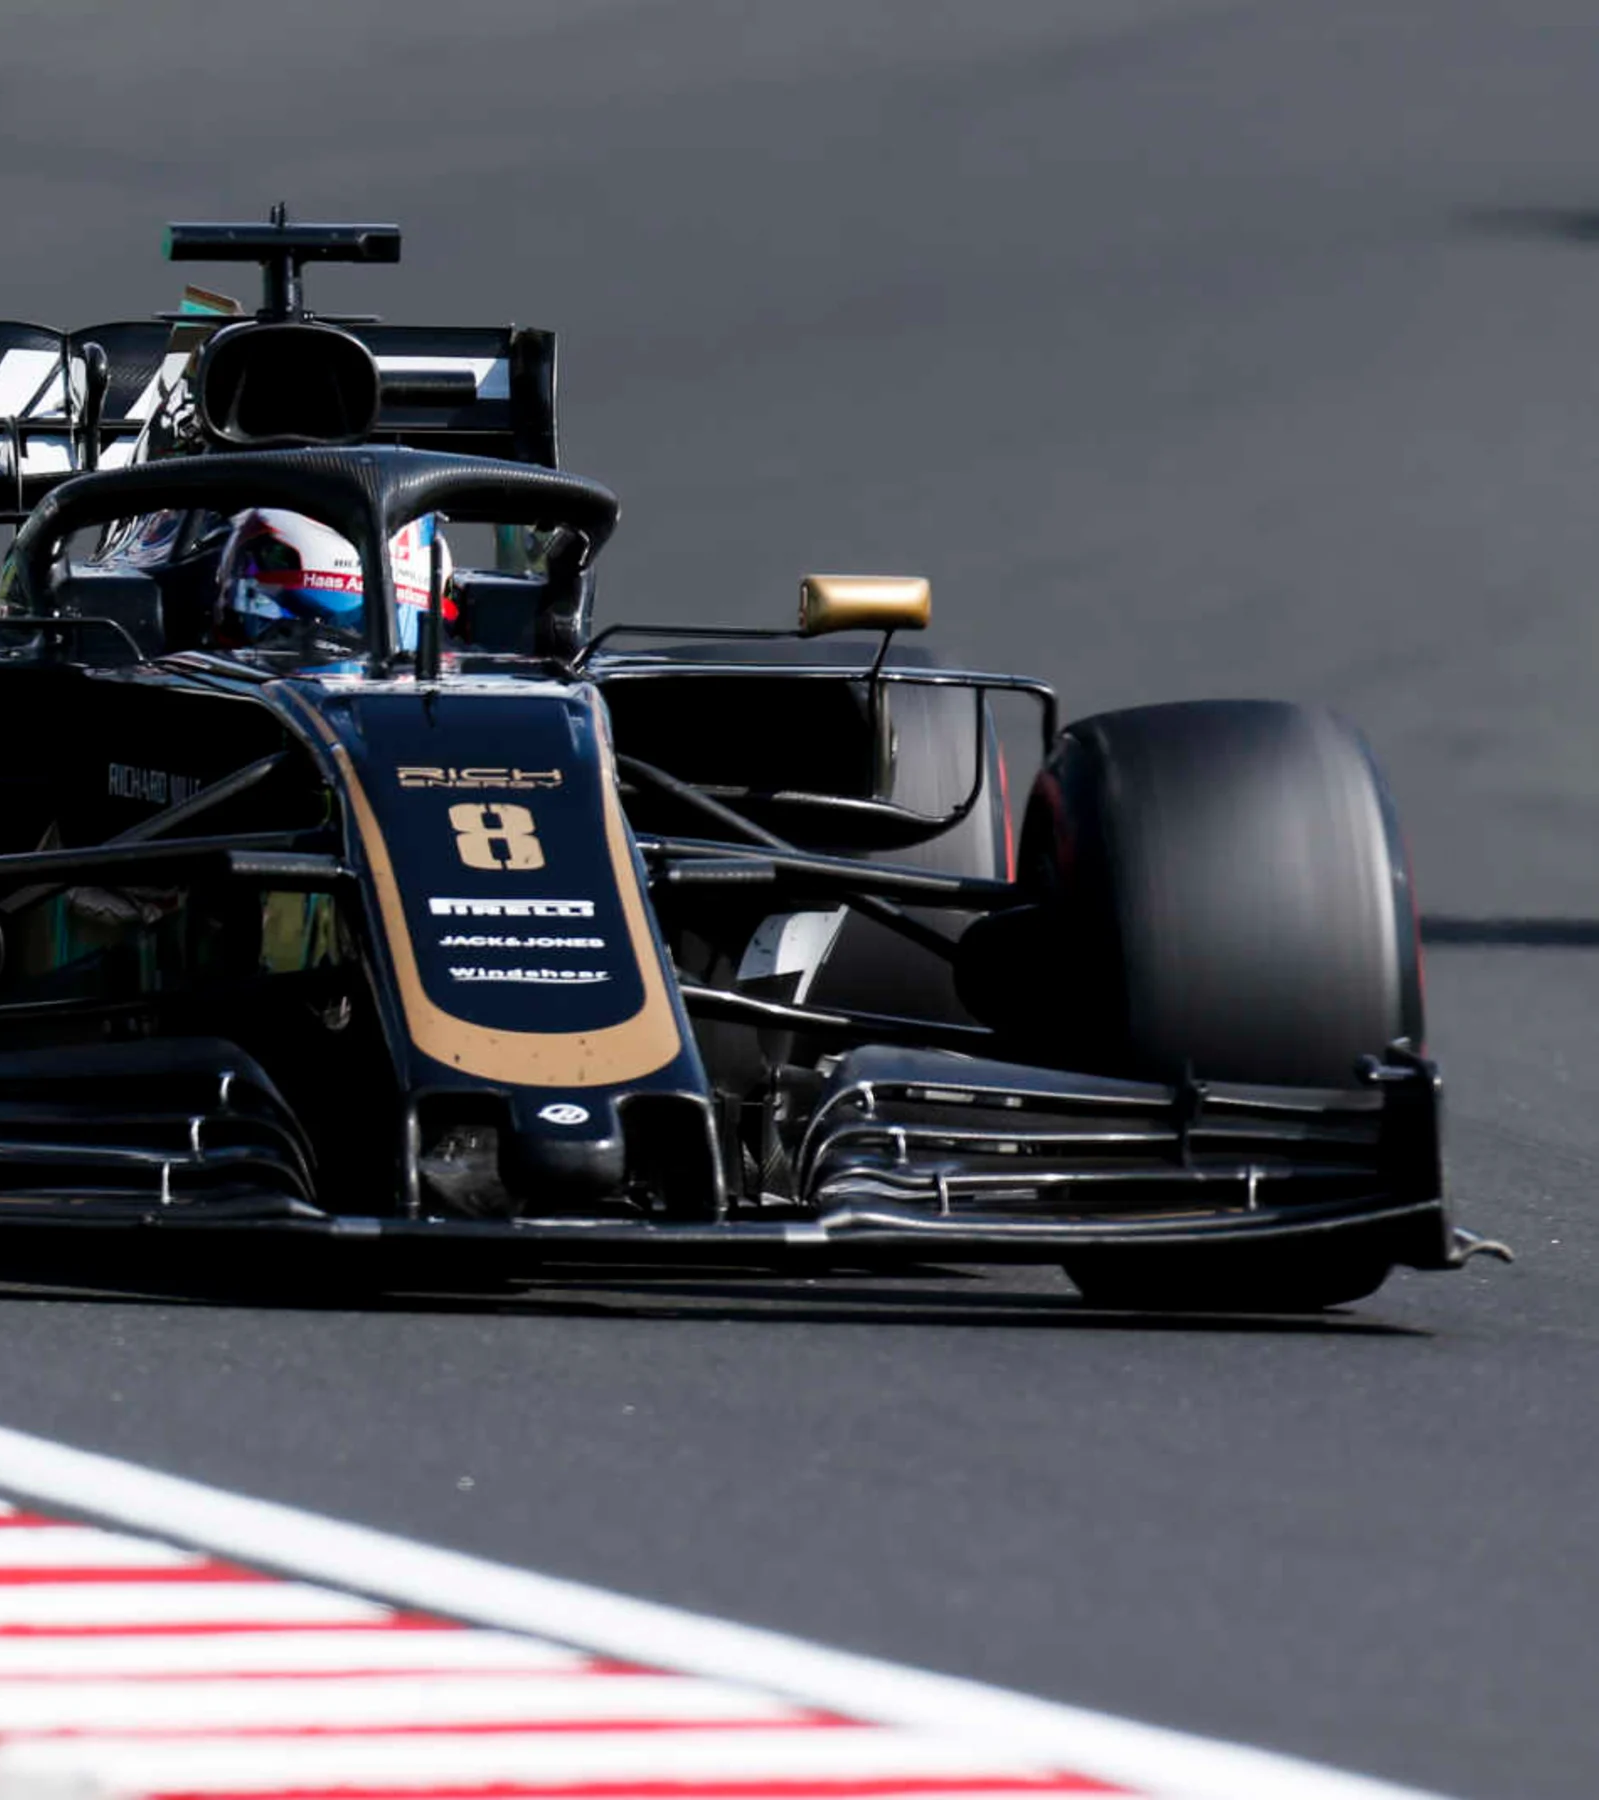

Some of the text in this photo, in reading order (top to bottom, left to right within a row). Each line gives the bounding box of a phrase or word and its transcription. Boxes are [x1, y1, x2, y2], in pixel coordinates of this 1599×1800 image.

[303, 573, 343, 589] Haas
[396, 767, 563, 781] RICH
[108, 762, 167, 804] RICHARD
[400, 779, 564, 789] ENERGY
[448, 802, 546, 871] 8
[429, 897, 595, 918] PIRELLI
[448, 966, 610, 982] Windshear
